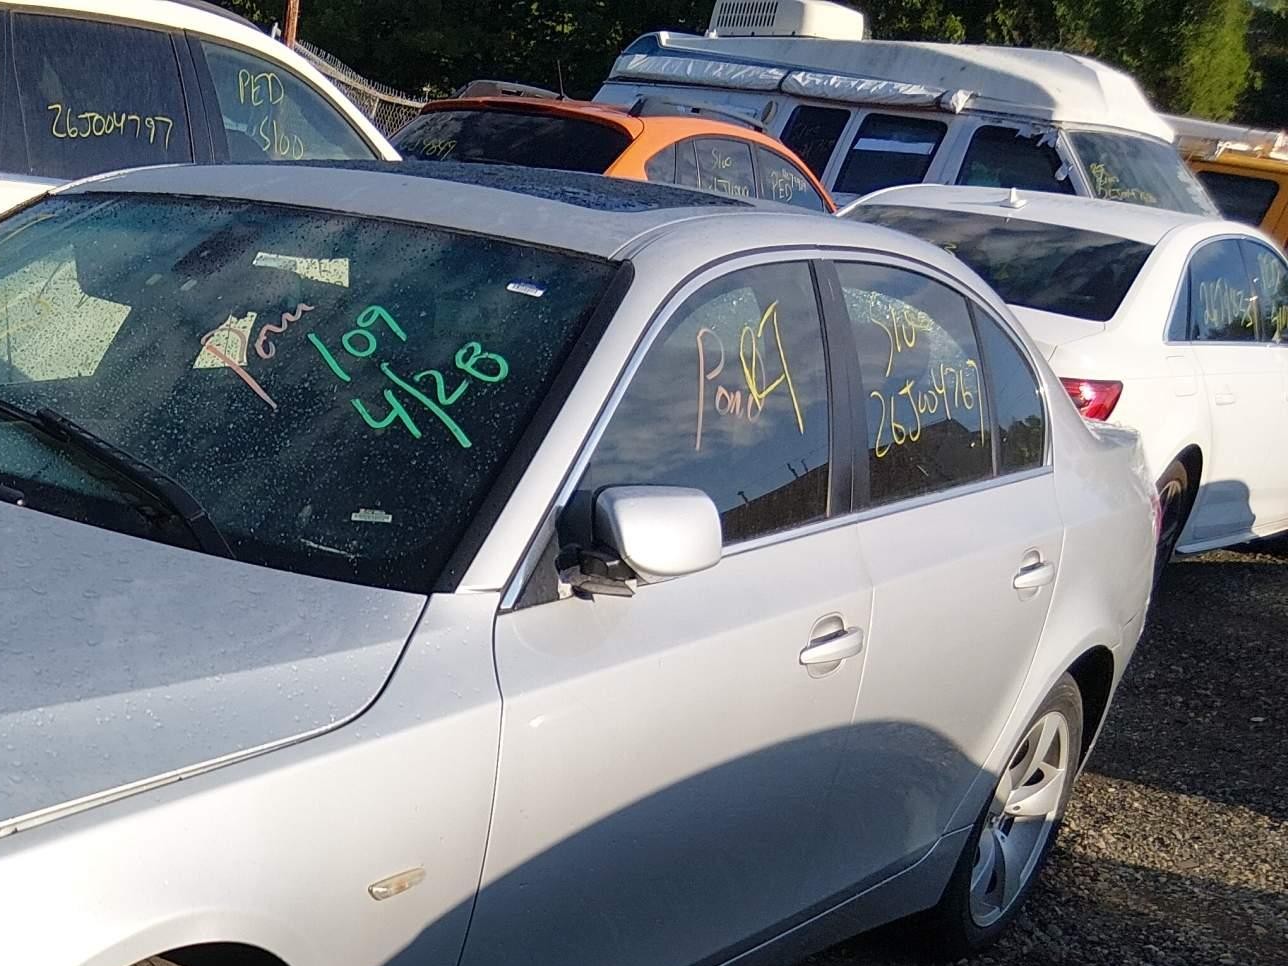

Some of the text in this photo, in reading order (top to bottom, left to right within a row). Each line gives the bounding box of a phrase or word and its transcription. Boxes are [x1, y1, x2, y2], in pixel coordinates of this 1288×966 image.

[238, 69, 285, 107] PED
[48, 104, 174, 150] 26J004797
[307, 304, 409, 384] 109
